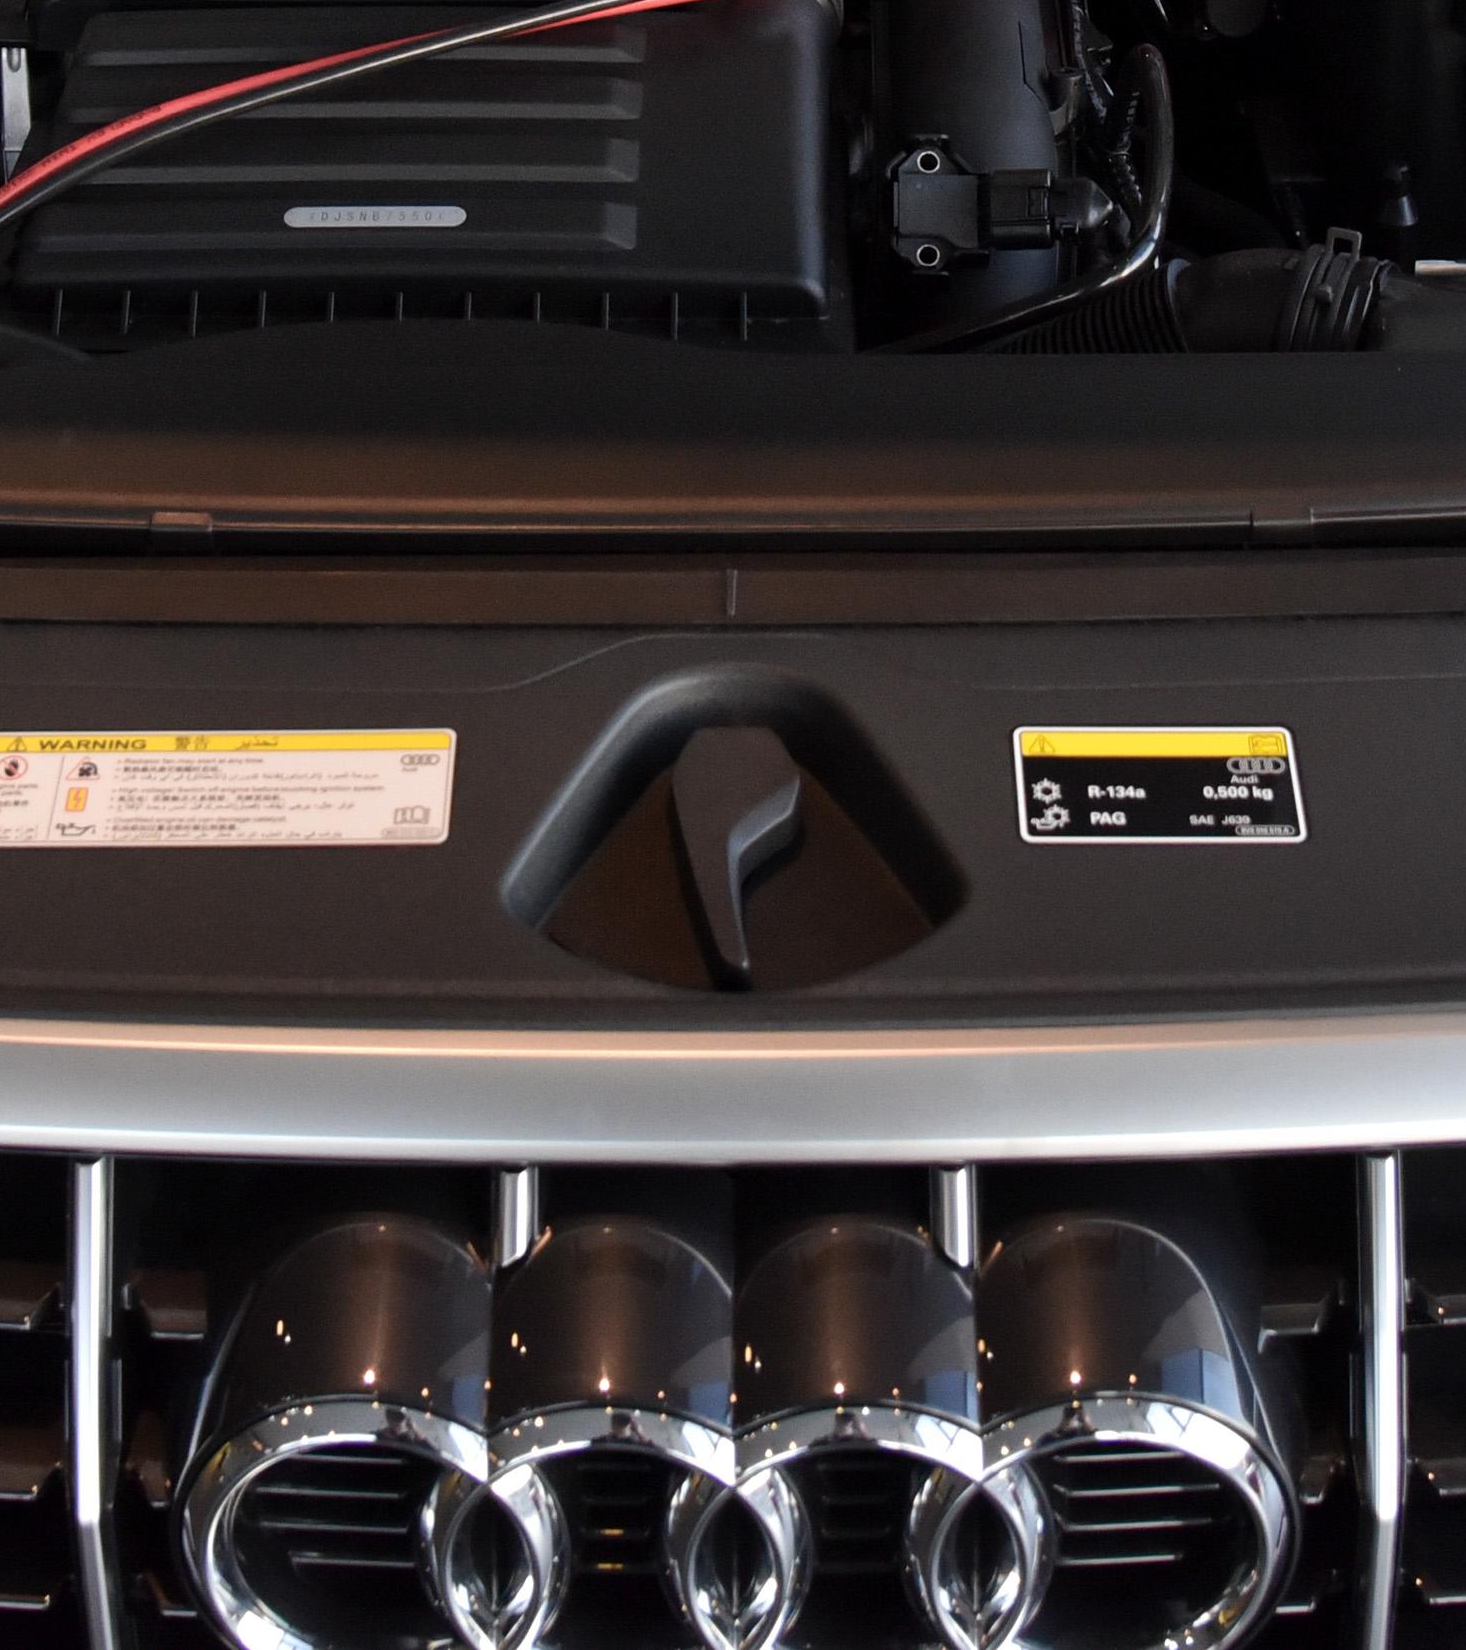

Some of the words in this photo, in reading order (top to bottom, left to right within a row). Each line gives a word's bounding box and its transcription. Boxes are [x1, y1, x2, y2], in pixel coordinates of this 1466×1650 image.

[38, 738, 148, 751] WARNING
[174, 736, 210, 751] 警告
[234, 736, 280, 751] تحذير
[1230, 774, 1259, 784] Audi
[1088, 785, 1146, 799] R-134a
[1203, 785, 1248, 800] 0,500
[1252, 785, 1274, 801] kg
[1090, 812, 1127, 825] PAG
[1189, 815, 1215, 825] SAE
[1221, 815, 1251, 825] J639
